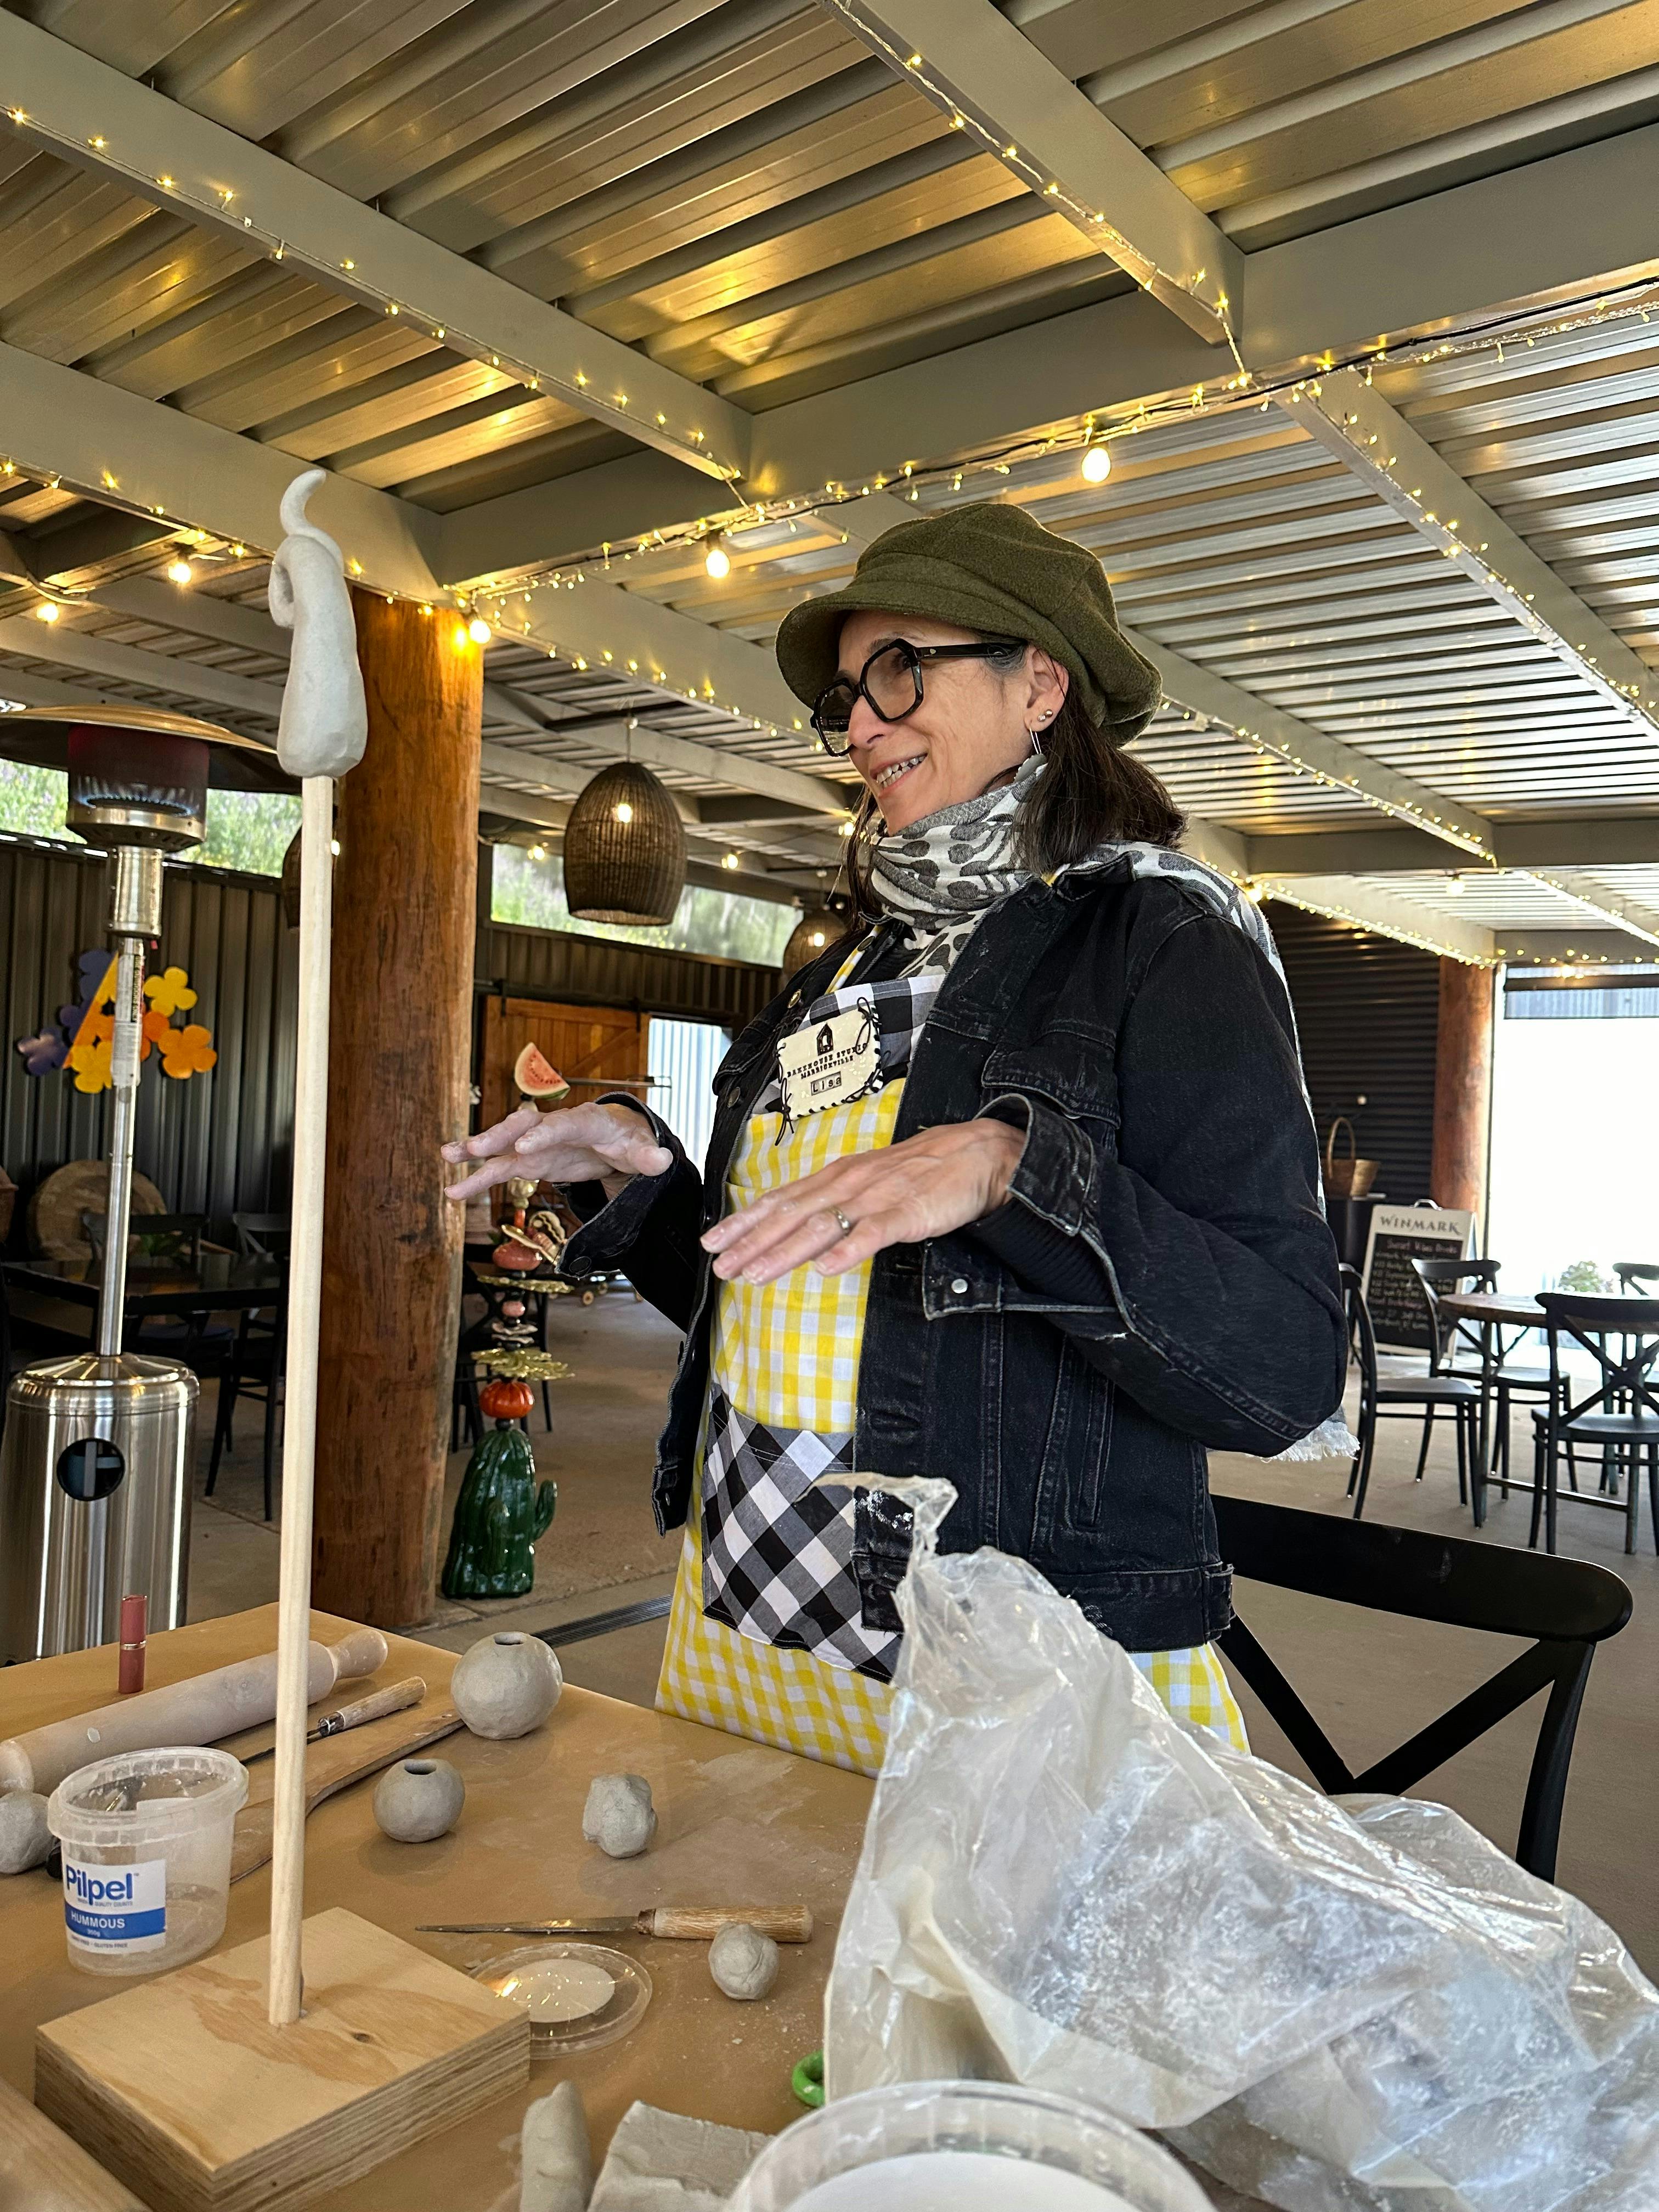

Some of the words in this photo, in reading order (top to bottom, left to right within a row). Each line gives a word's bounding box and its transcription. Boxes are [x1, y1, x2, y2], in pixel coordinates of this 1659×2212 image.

[787, 1054, 833, 1077] BAKEHOUSE
[801, 1055, 854, 1079] MARRICKVILLE
[1380, 1215, 1462, 1235] WINMARK
[66, 1864, 133, 1906] Pilpel
[71, 1910, 125, 1928] HUMMOUS
